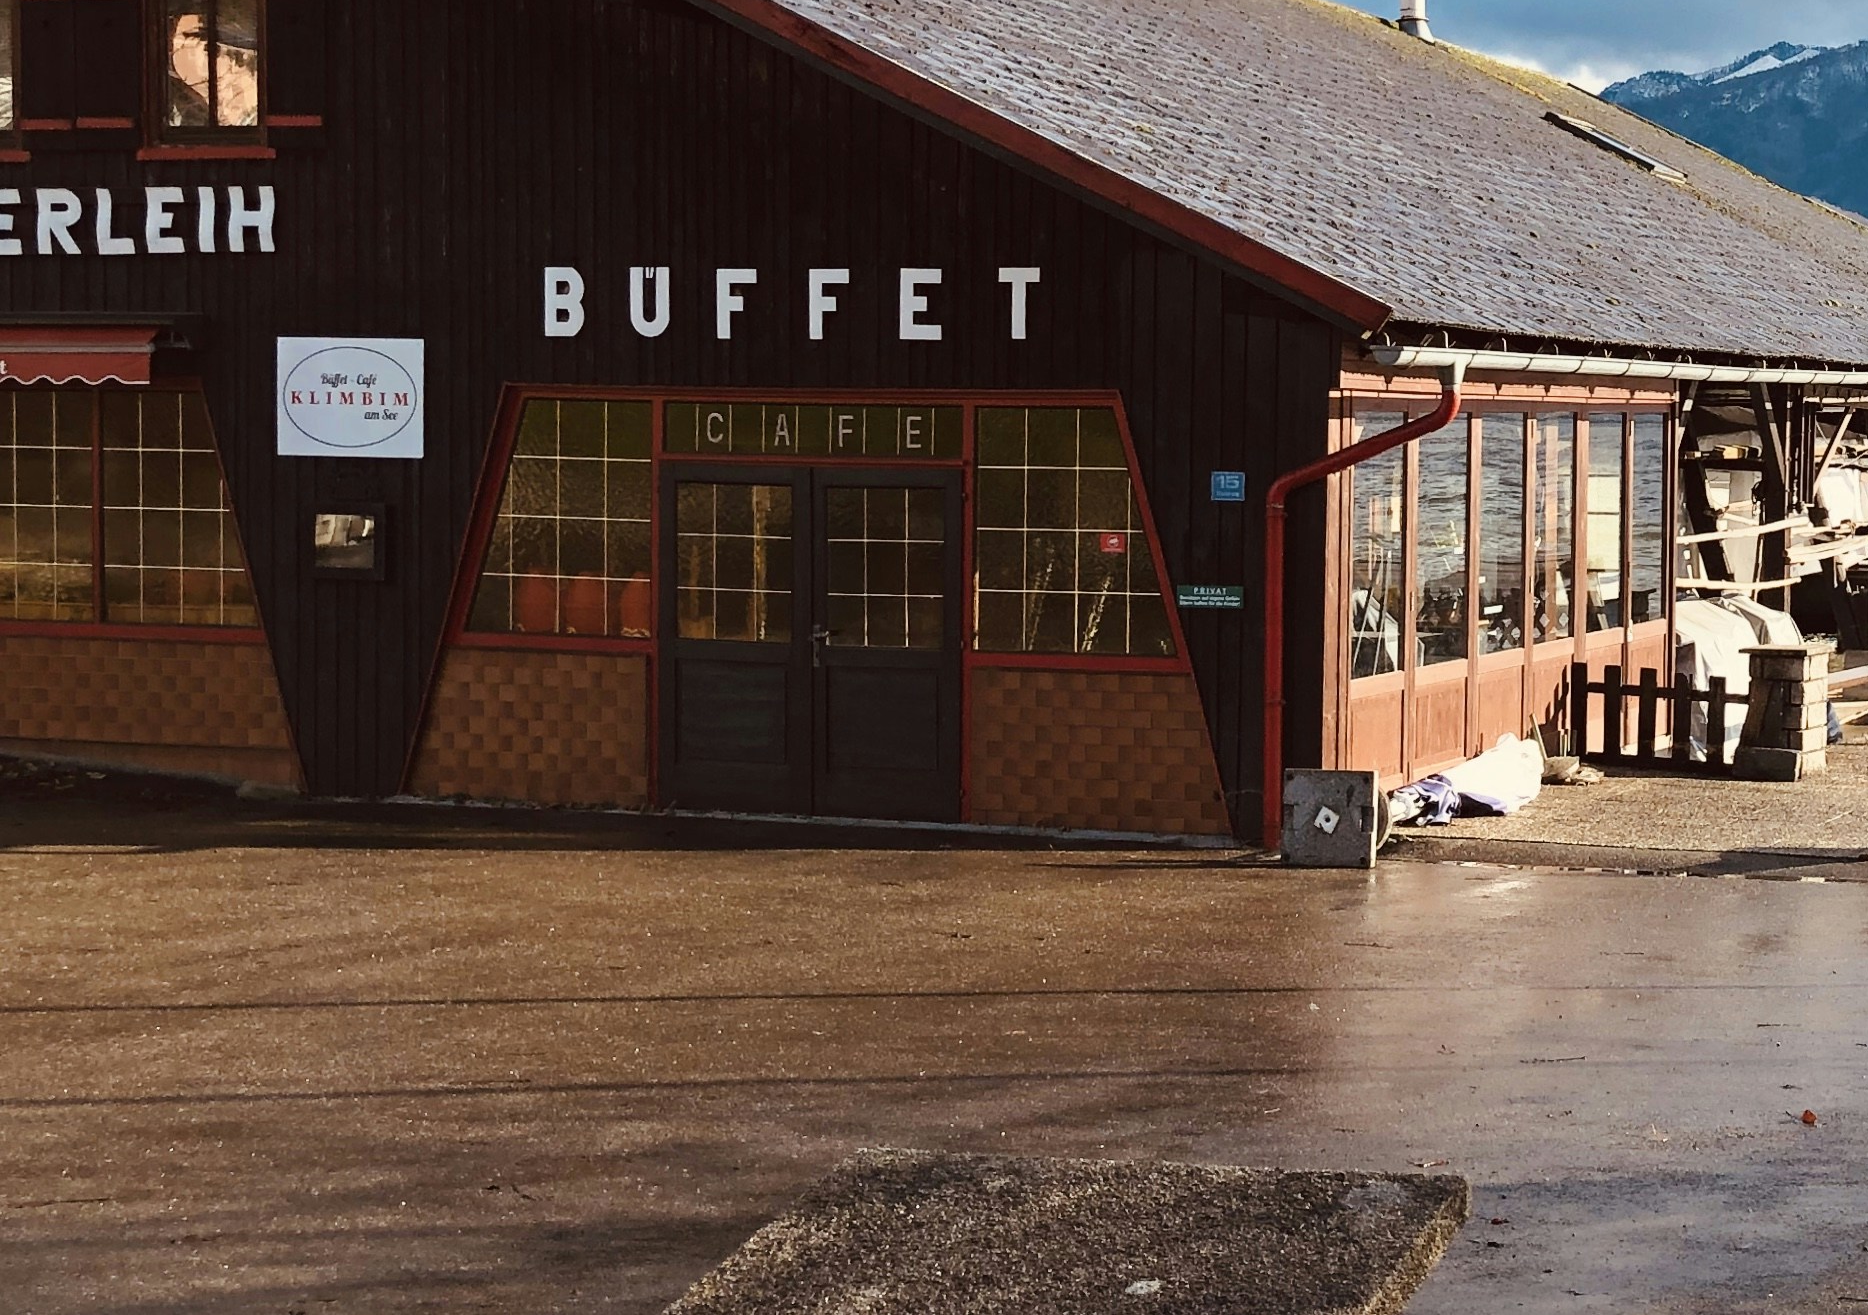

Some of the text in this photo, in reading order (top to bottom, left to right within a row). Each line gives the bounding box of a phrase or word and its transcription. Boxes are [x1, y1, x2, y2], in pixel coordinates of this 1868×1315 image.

[0, 186, 276, 255] ERLEIH
[545, 266, 1040, 341] BÜFFET
[291, 390, 409, 406] KLIMBIM
[364, 409, 399, 420] am See
[1216, 475, 1240, 489] 15
[1193, 586, 1227, 595] PRIVAT
